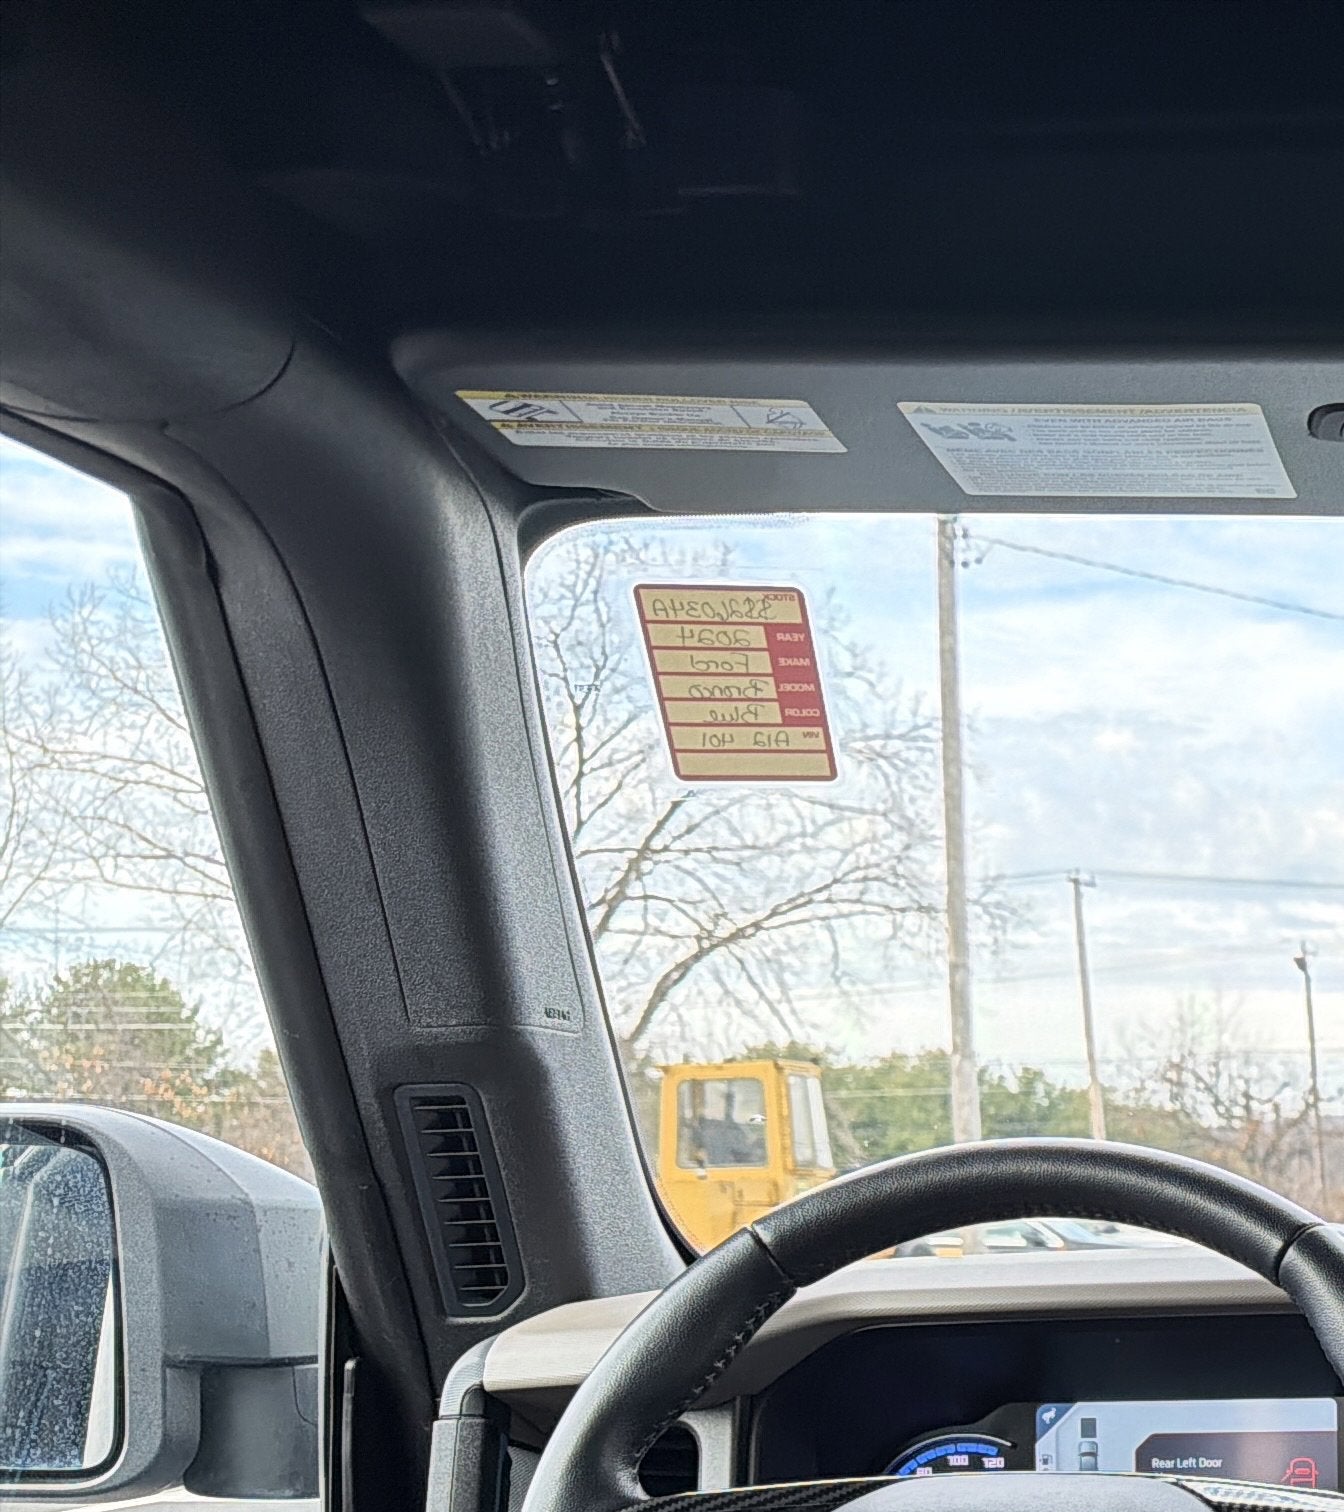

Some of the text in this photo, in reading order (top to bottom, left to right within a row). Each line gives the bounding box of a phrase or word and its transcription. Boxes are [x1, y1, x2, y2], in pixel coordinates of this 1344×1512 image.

[982, 1457, 1004, 1468] 120
[1152, 1457, 1223, 1469] Rear Left Door
